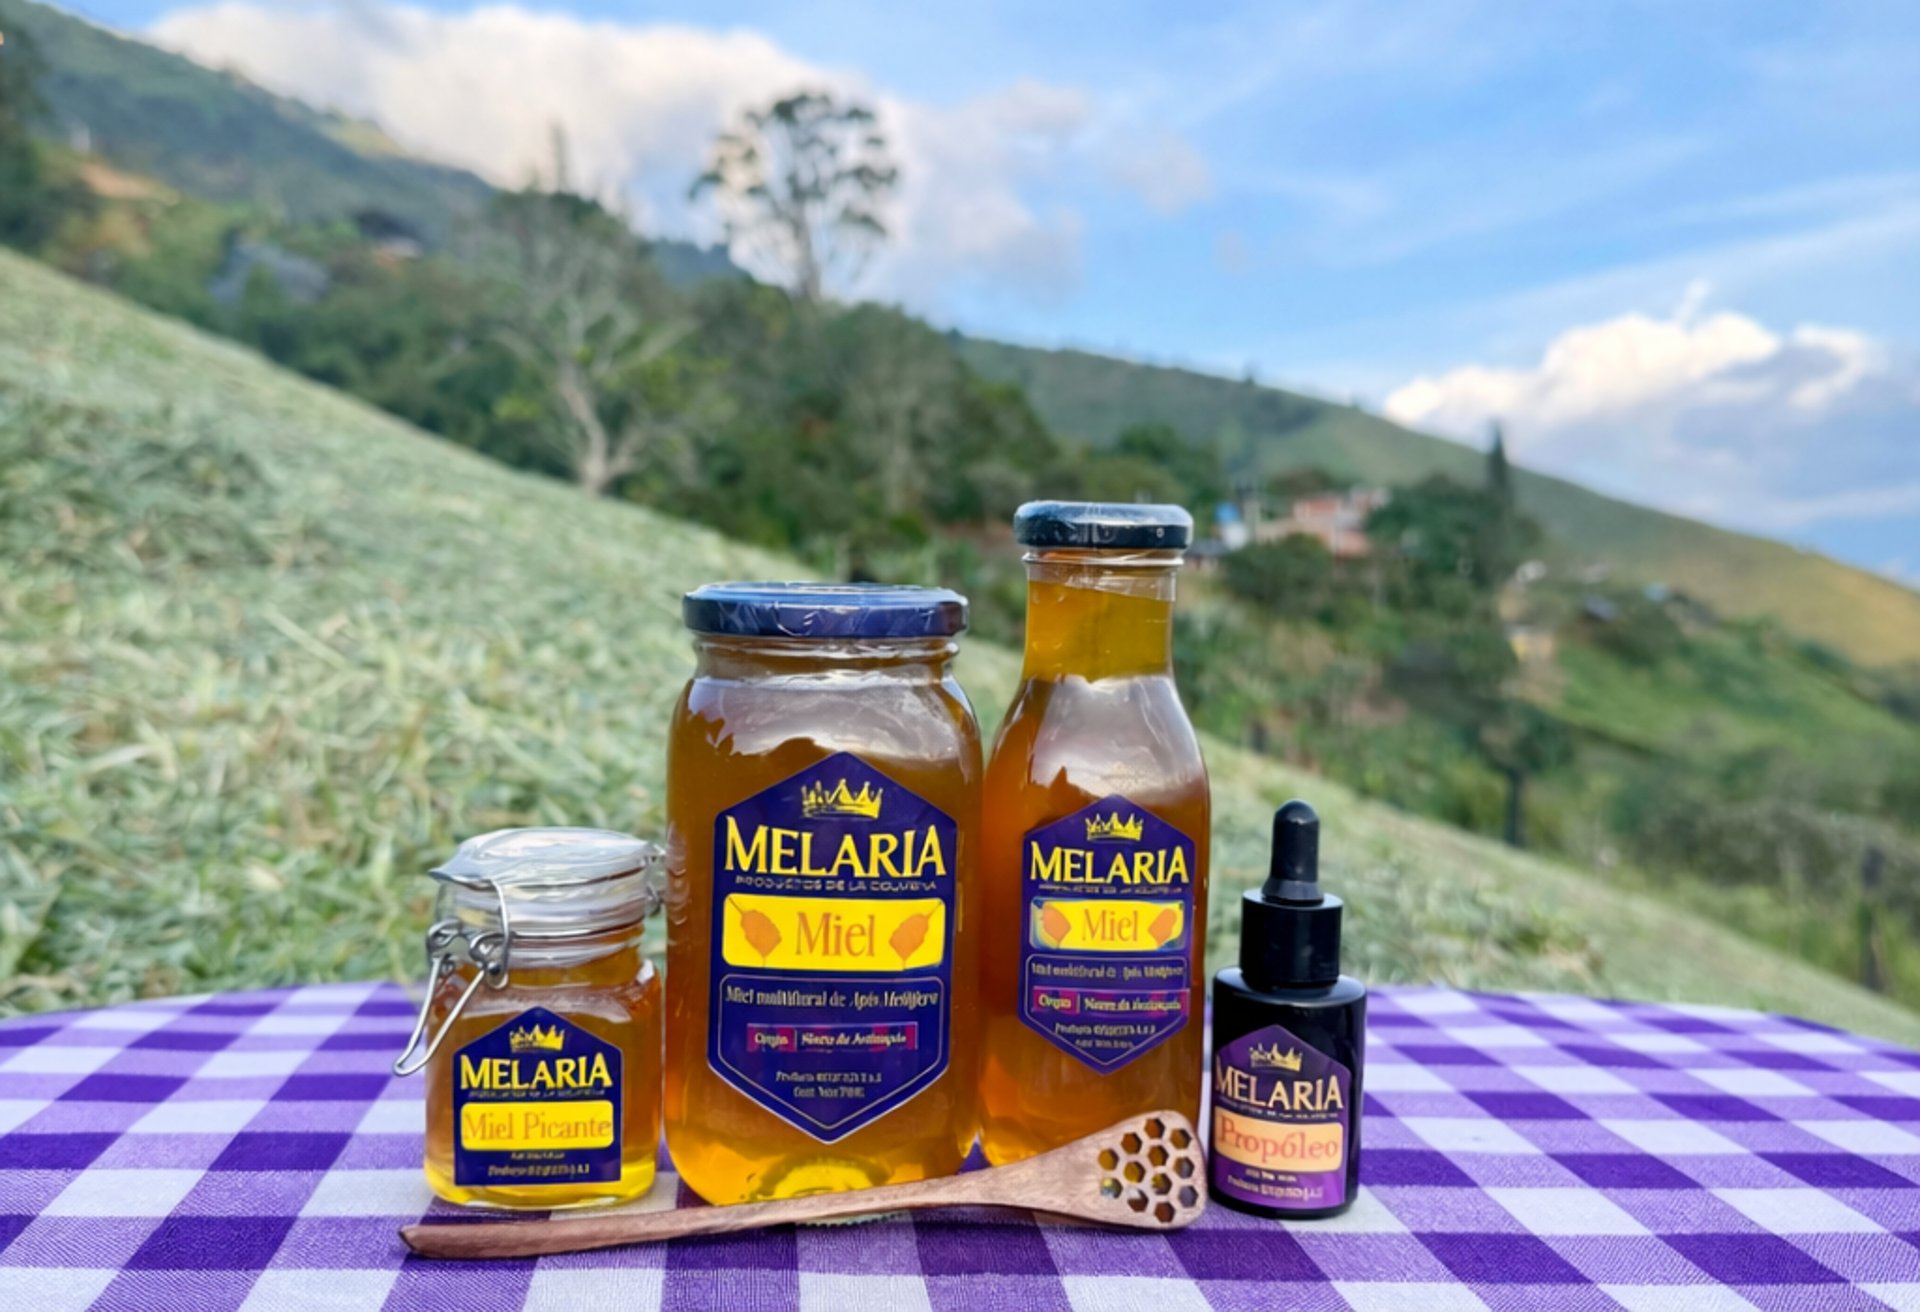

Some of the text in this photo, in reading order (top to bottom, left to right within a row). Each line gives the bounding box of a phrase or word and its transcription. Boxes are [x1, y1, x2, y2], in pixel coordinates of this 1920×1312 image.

[725, 815, 946, 878] MELARIA
[1030, 841, 1190, 885] MELARIA
[795, 911, 875, 957] Miel
[1082, 908, 1139, 942] Miel
[460, 1052, 613, 1090] MELARIA
[1215, 1055, 1344, 1112] MELARIA
[463, 1111, 611, 1140] Miel Picante
[1220, 1115, 1339, 1163] Propóleo
